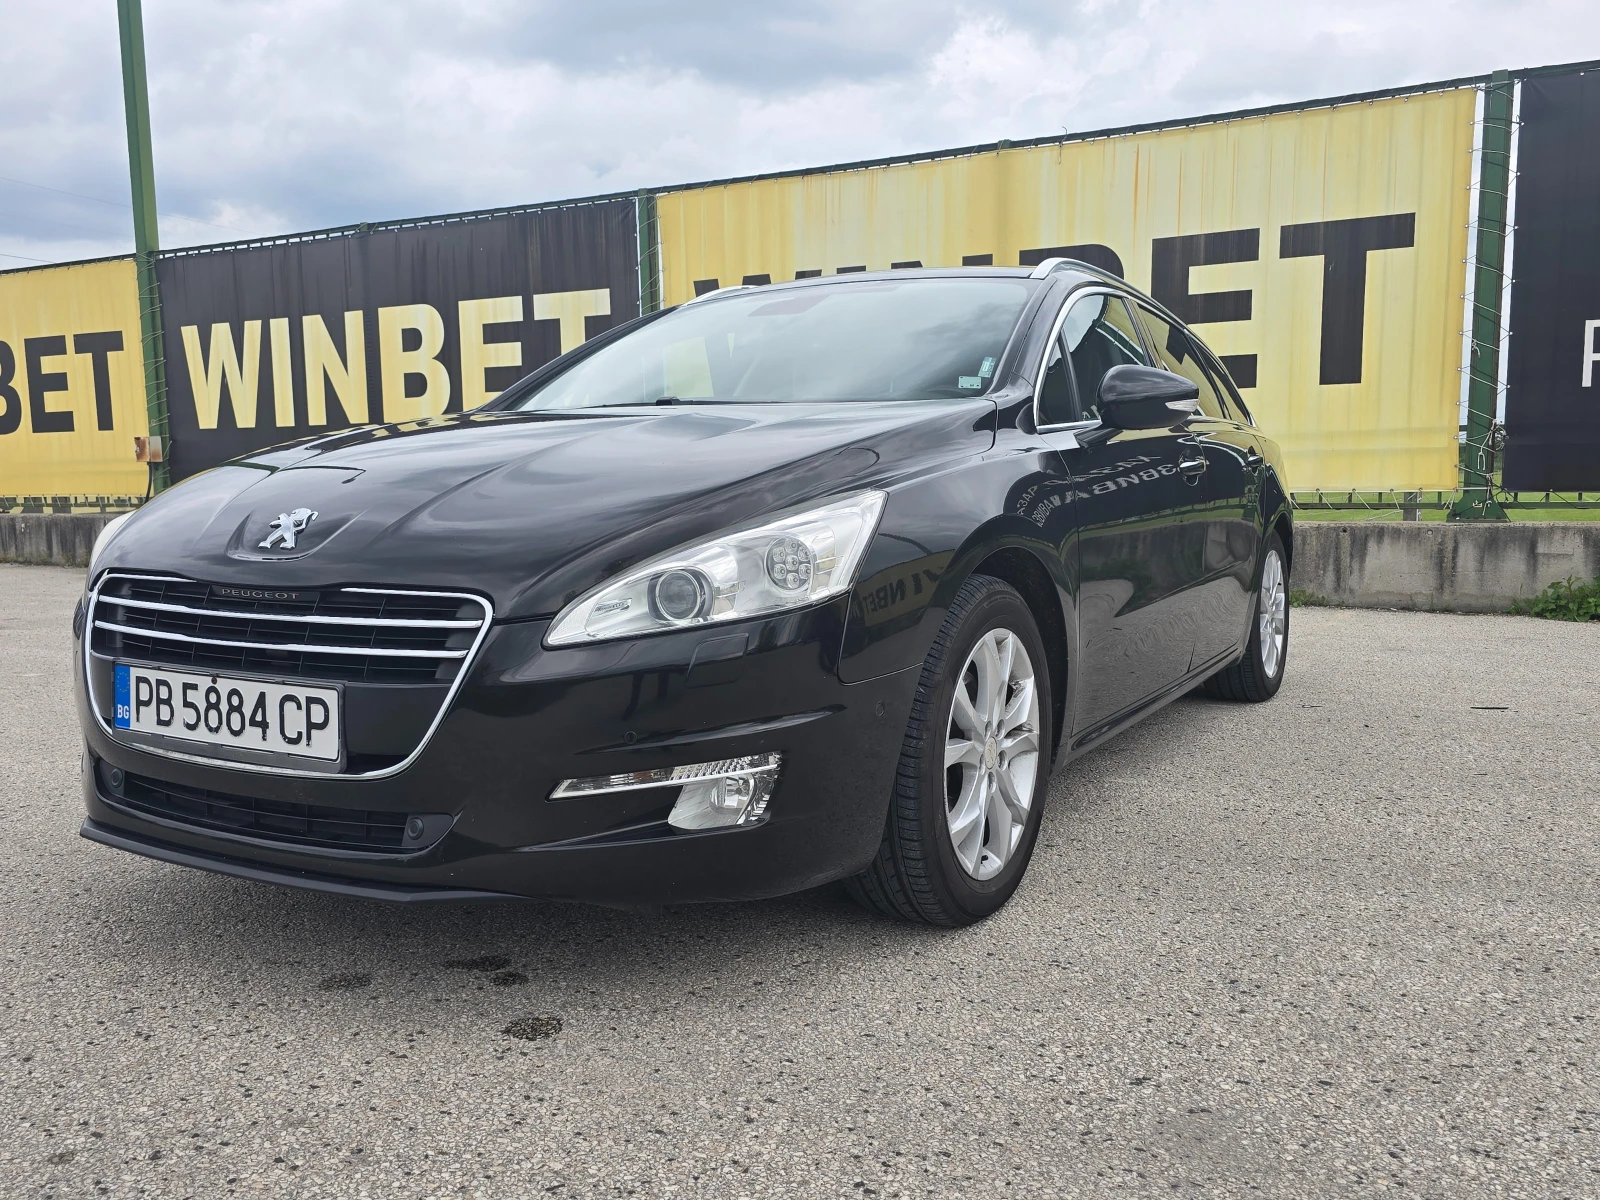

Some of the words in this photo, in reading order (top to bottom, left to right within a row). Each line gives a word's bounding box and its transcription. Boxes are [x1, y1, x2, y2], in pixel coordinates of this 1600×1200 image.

[181, 288, 612, 430] WINBET
[222, 588, 300, 600] PEUGEOT
[117, 704, 130, 720] BG
[135, 675, 175, 727] PB
[182, 682, 270, 742] 5884
[279, 693, 330, 748] CP
